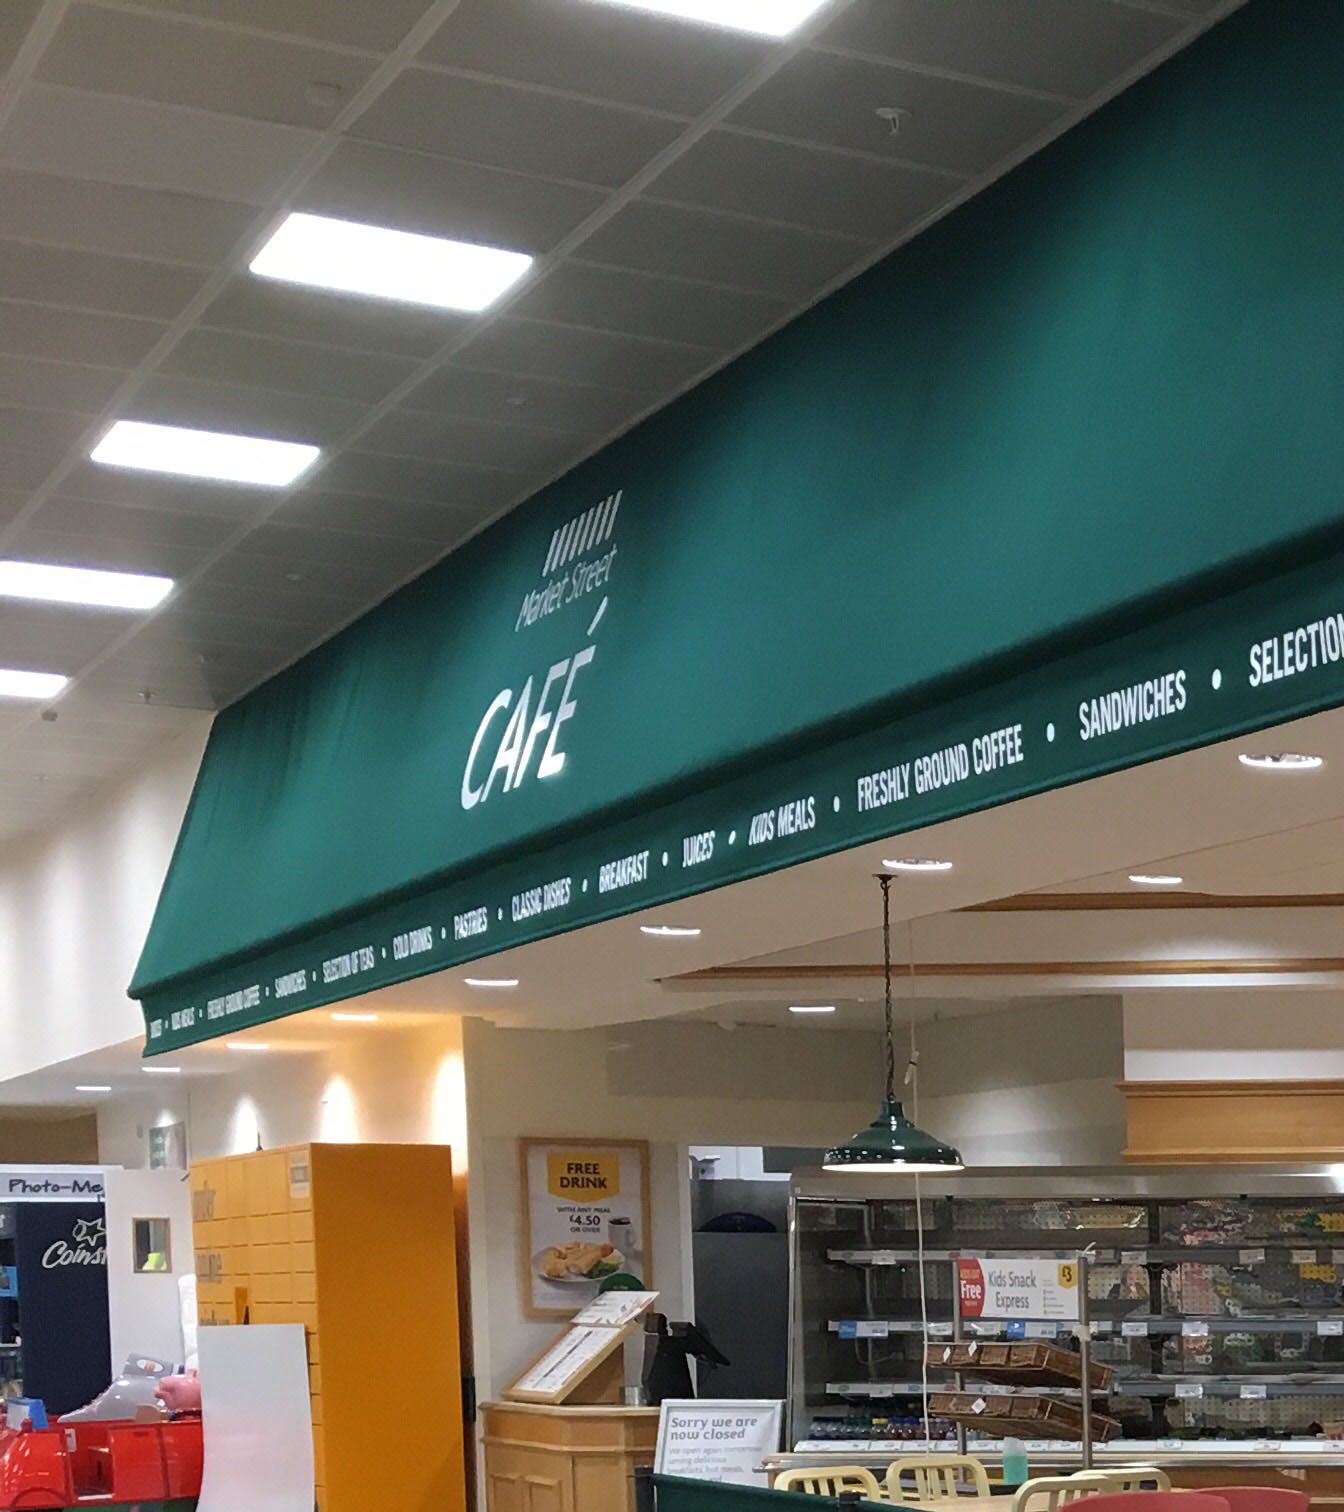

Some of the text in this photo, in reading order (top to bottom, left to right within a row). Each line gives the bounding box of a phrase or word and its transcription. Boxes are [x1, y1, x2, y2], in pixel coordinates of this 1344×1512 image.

[515, 544, 617, 632] Market Street
[461, 596, 608, 809] CAFÉ
[393, 931, 409, 960] COLD
[409, 926, 432, 955] DRINKS
[454, 906, 488, 940] PASTRIES
[511, 887, 543, 922] CLASSIC
[543, 876, 572, 911] DISHES
[599, 850, 649, 893] BREAKFAST
[682, 830, 715, 868] JUICES
[748, 809, 774, 846] KIDS
[777, 796, 816, 837] MEALS
[857, 762, 911, 812] FRESHLY
[914, 743, 969, 796] GROUND
[972, 724, 1024, 775] COFFEE
[1079, 670, 1187, 741] SANDWICHES
[567, 1162, 600, 1174] FREE
[9, 1179, 103, 1193] Photo-Me
[559, 1176, 607, 1189] DRINK
[569, 1215, 601, 1226] £4.50
[988, 1269, 1007, 1288] Kids
[1009, 1269, 1037, 1289] Snack
[1061, 1265, 1072, 1282] £3
[960, 1279, 982, 1299] Free
[995, 1291, 1030, 1312] Express
[671, 1417, 758, 1430] Sorry we are
[670, 1428, 745, 1440] now closed
